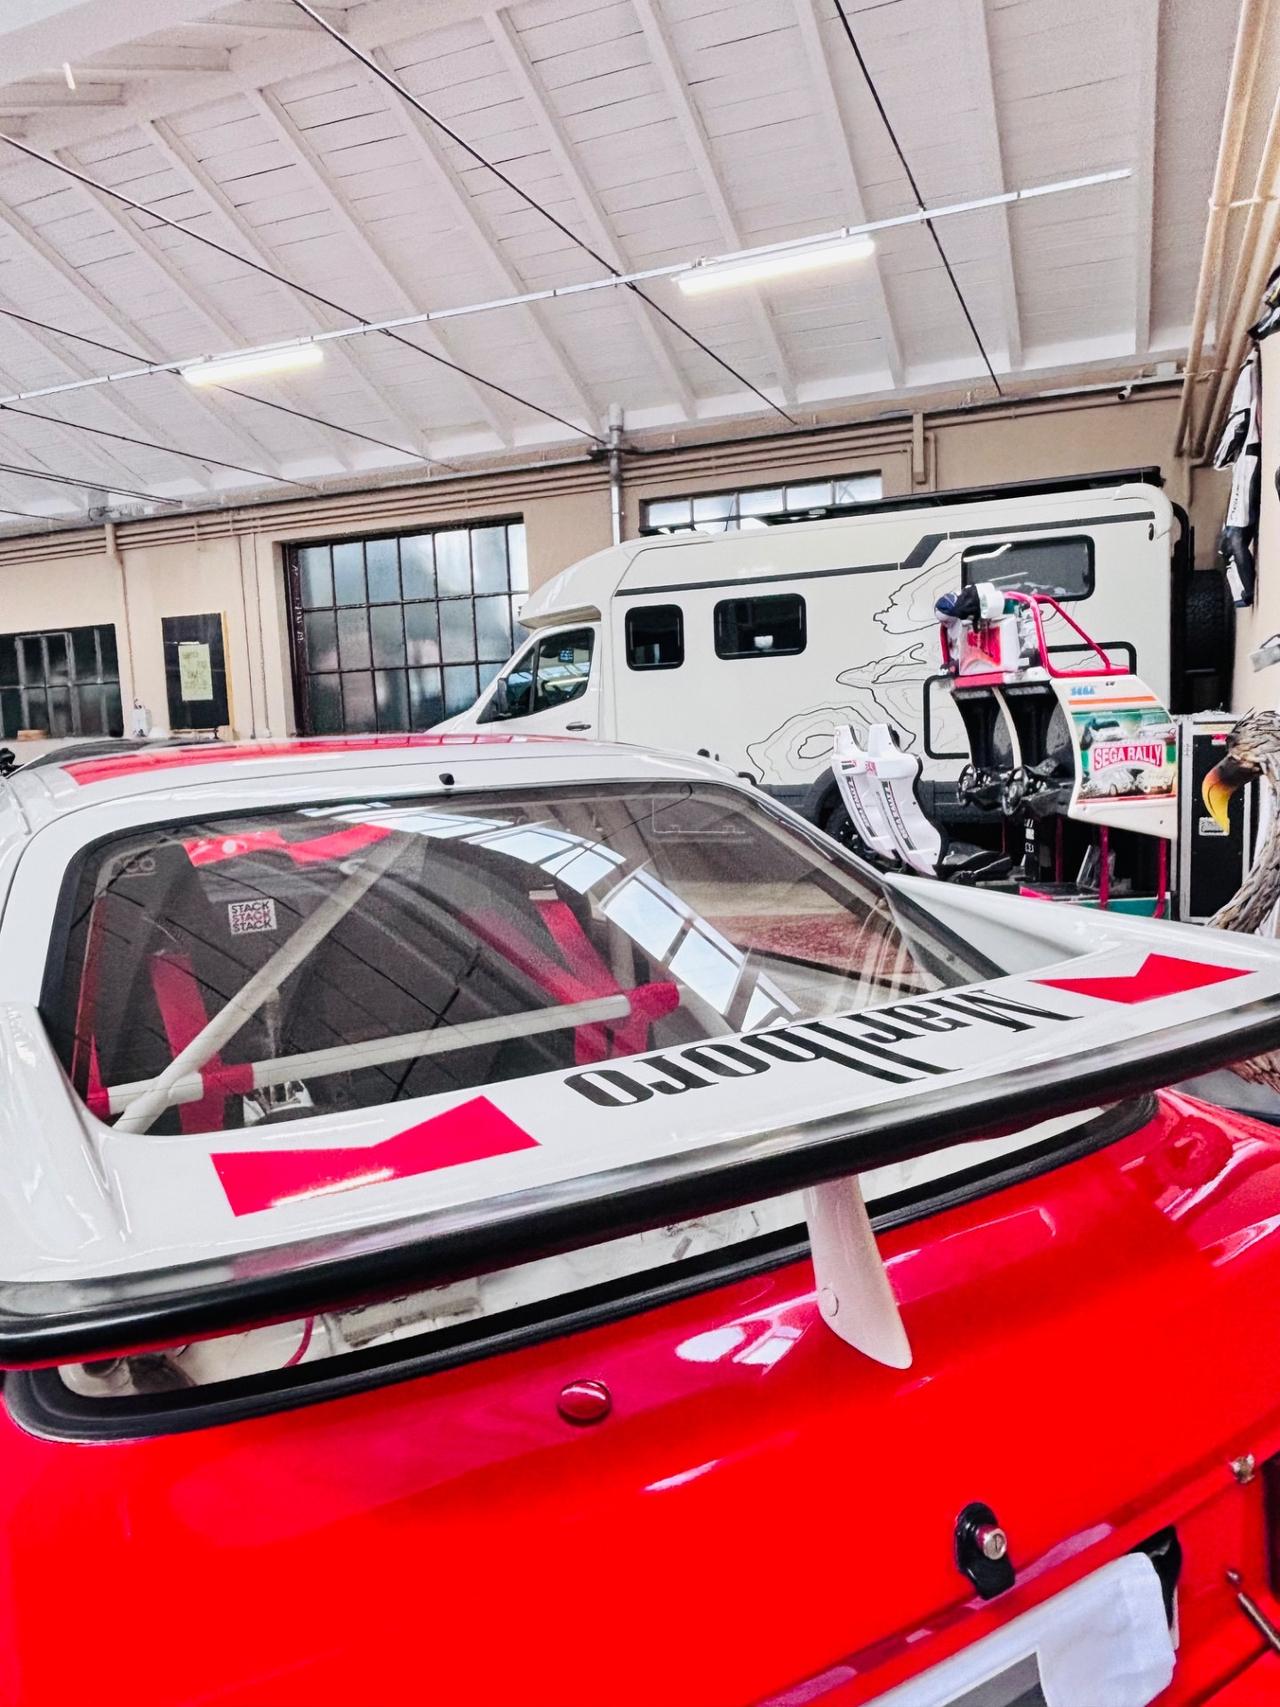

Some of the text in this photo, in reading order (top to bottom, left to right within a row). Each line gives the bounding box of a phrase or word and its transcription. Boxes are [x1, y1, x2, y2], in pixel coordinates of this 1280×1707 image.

[1071, 687, 1094, 696] SEGA
[1094, 744, 1162, 771] SEGA RALLY
[231, 901, 270, 914] STACK
[232, 910, 271, 923] STACK
[233, 919, 272, 933] STACK
[563, 989, 1083, 1107] Marlboro
